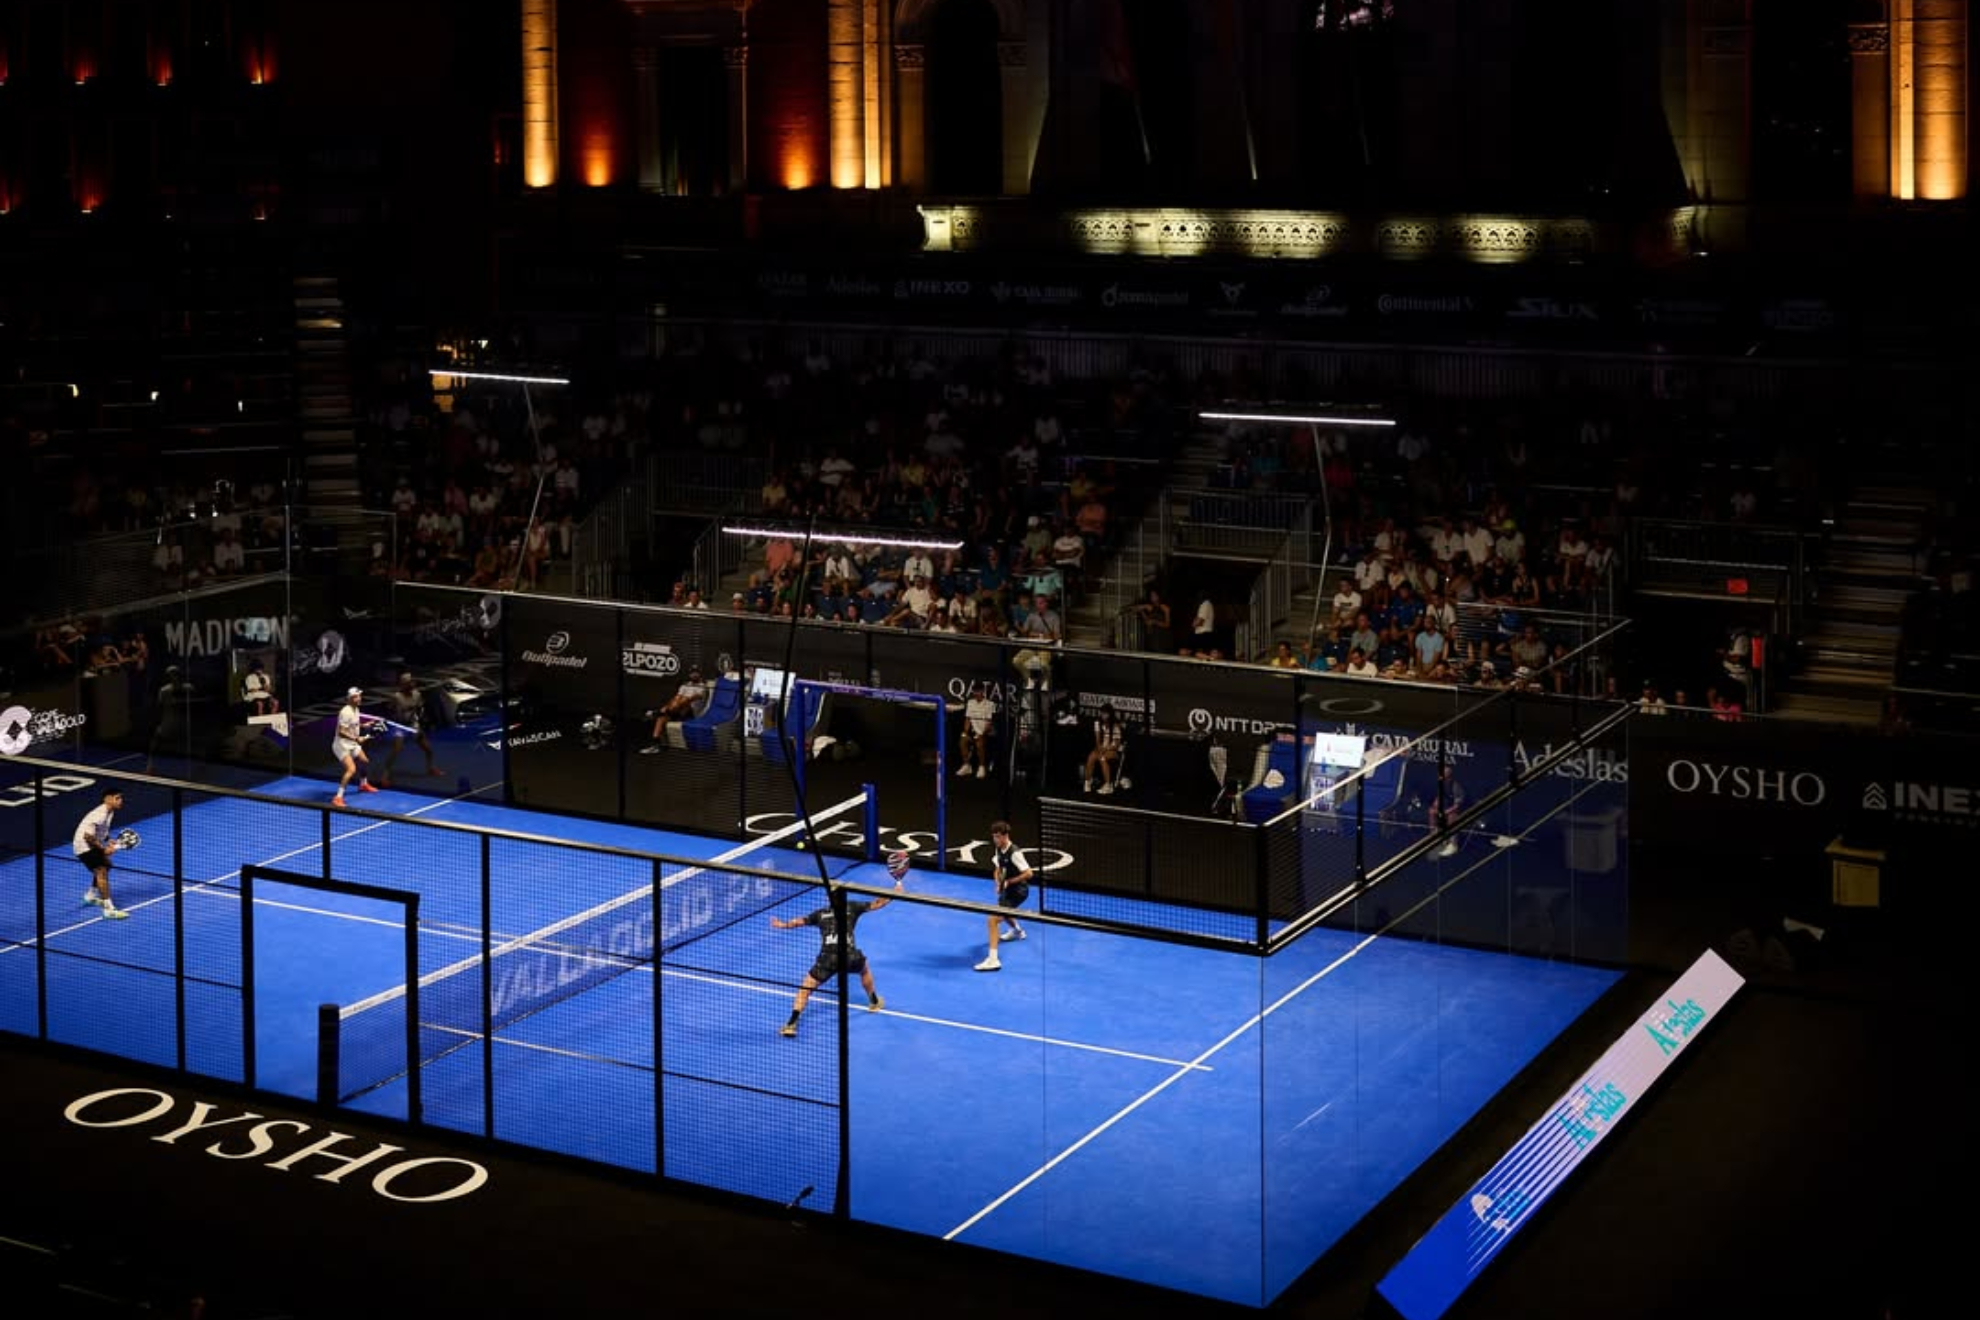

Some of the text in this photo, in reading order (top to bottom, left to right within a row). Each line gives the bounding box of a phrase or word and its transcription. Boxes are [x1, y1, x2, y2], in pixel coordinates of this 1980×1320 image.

[1666, 759, 1827, 807] OYSHO
[1893, 781, 1980, 816] INE
[63, 1087, 489, 1204] OYSHO
